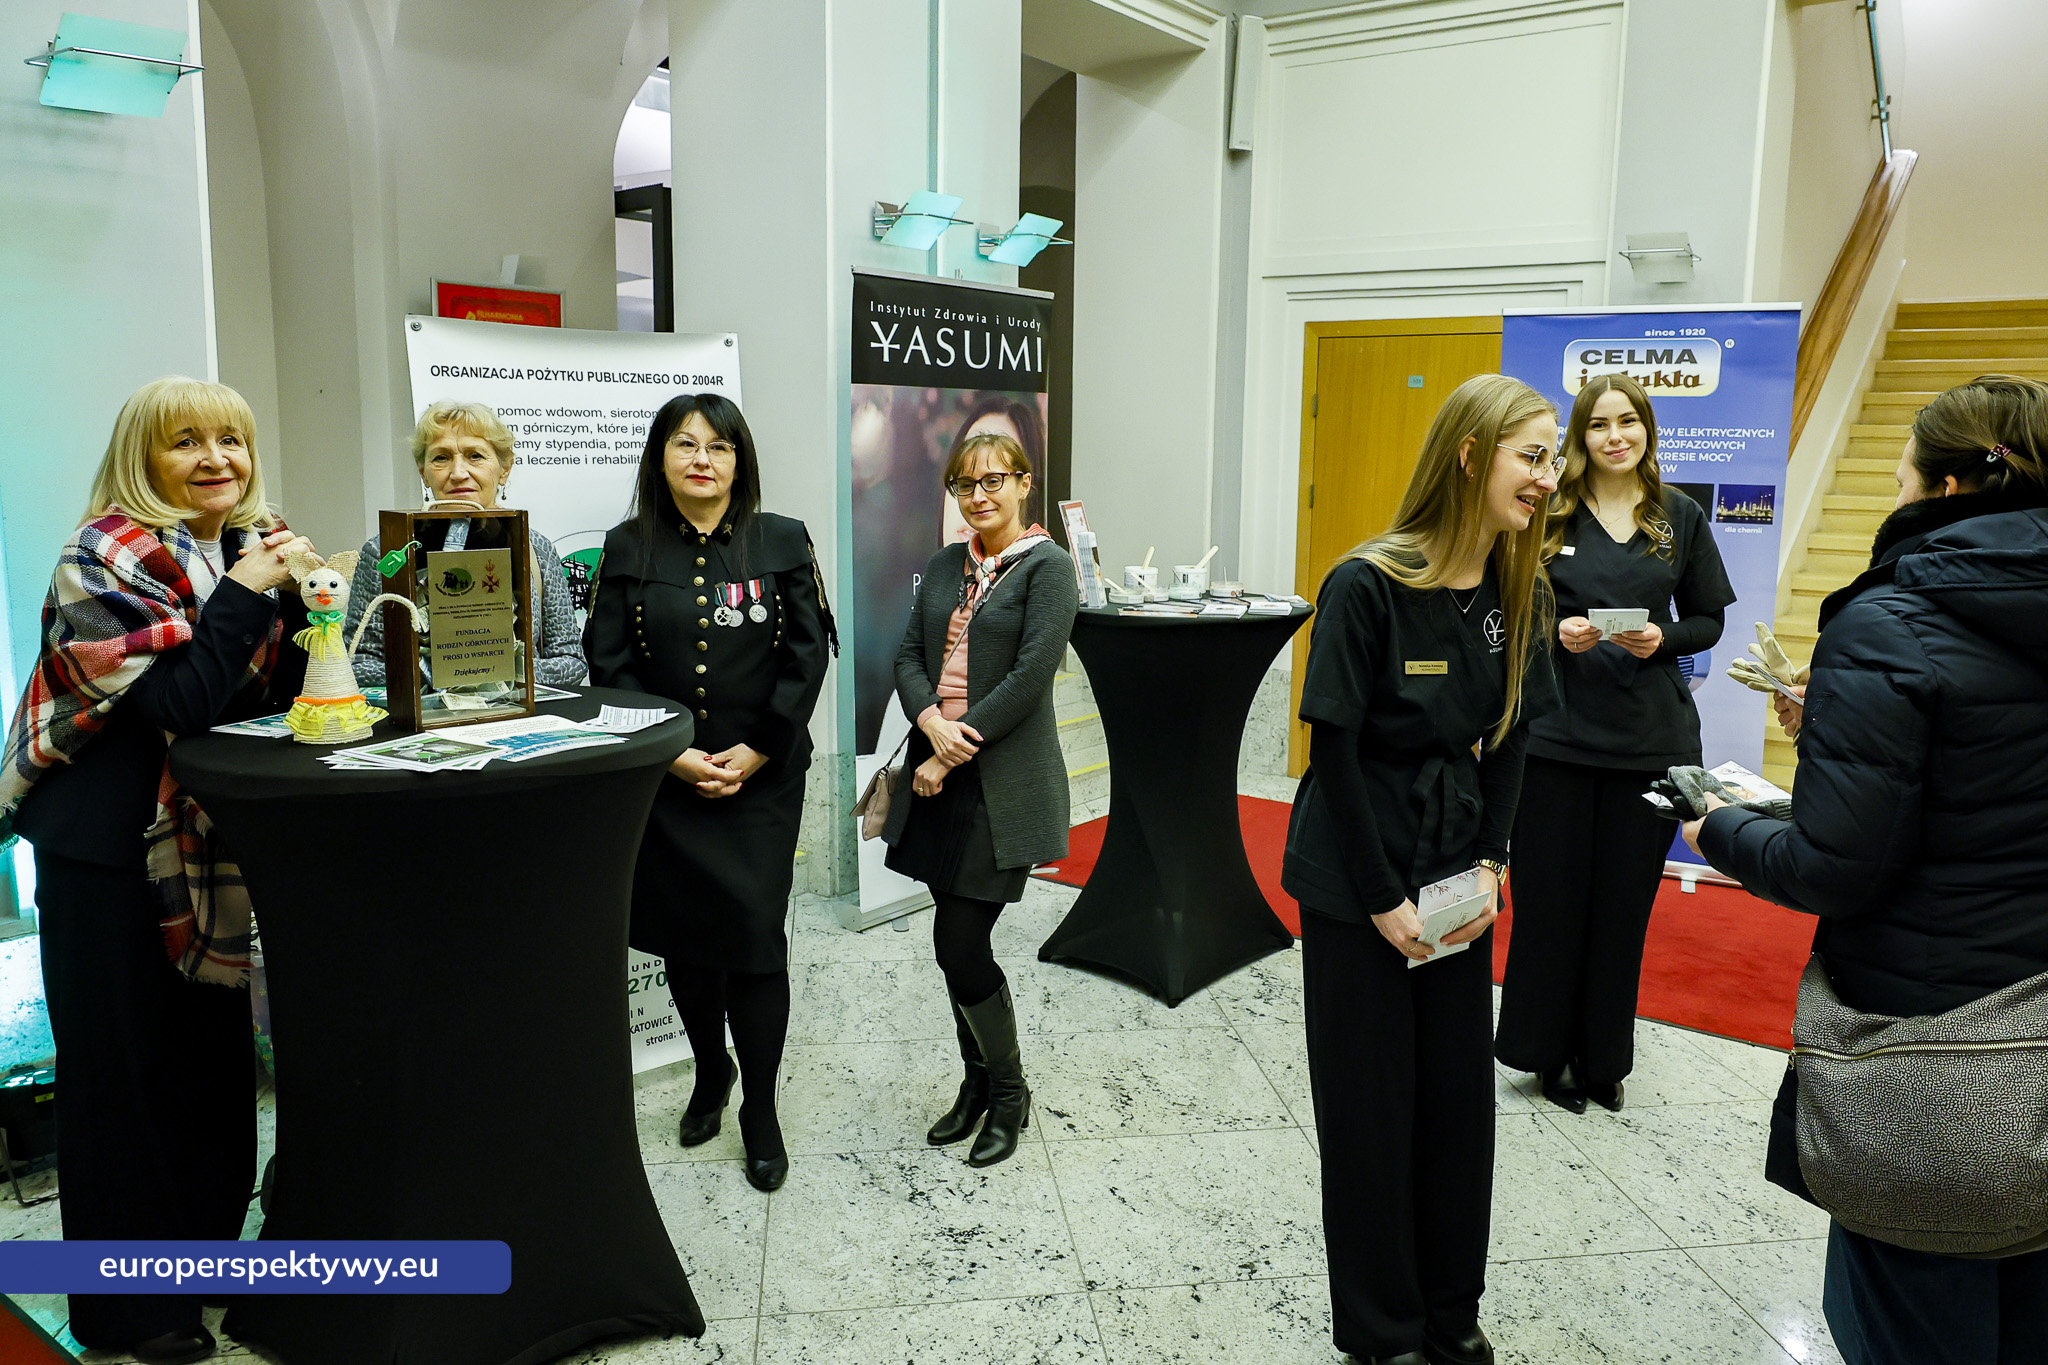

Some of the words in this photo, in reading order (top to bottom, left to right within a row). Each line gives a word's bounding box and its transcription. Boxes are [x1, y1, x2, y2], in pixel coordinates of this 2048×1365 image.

[869, 300, 926, 318] Instytut
[934, 307, 987, 324] Zdrowia
[995, 314, 1000, 325] i
[1007, 316, 1042, 332] Urody
[1644, 329, 1676, 337] since
[1679, 328, 1706, 336] 1920
[1580, 349, 1698, 365] CELMA
[430, 365, 524, 380] ORGANIZACJA
[527, 367, 584, 382] POŻYTKU
[587, 371, 670, 385] PUBLICZNEGO
[673, 374, 689, 386] OD
[692, 375, 724, 387] 2004R
[497, 407, 542, 418] pomoc
[545, 407, 606, 419] wdowom,
[523, 422, 593, 435] górniczym,
[596, 422, 628, 434] które
[631, 423, 646, 436] jej
[1677, 427, 1775, 438] ELEKTRYCZNYCH
[545, 438, 611, 450] stypendia,
[527, 454, 581, 465] leczenie
[584, 454, 588, 464] i
[1698, 453, 1733, 462] MOCY
[1737, 526, 1763, 534] chemii
[456, 628, 491, 636] FUNDACJA
[437, 641, 463, 649] RODZIN
[465, 638, 509, 647] GÓRNICZYCH
[442, 653, 463, 661] PROSI
[464, 652, 470, 660] O
[629, 1015, 672, 1034] KATOWICE
[646, 1031, 676, 1046] strona:
